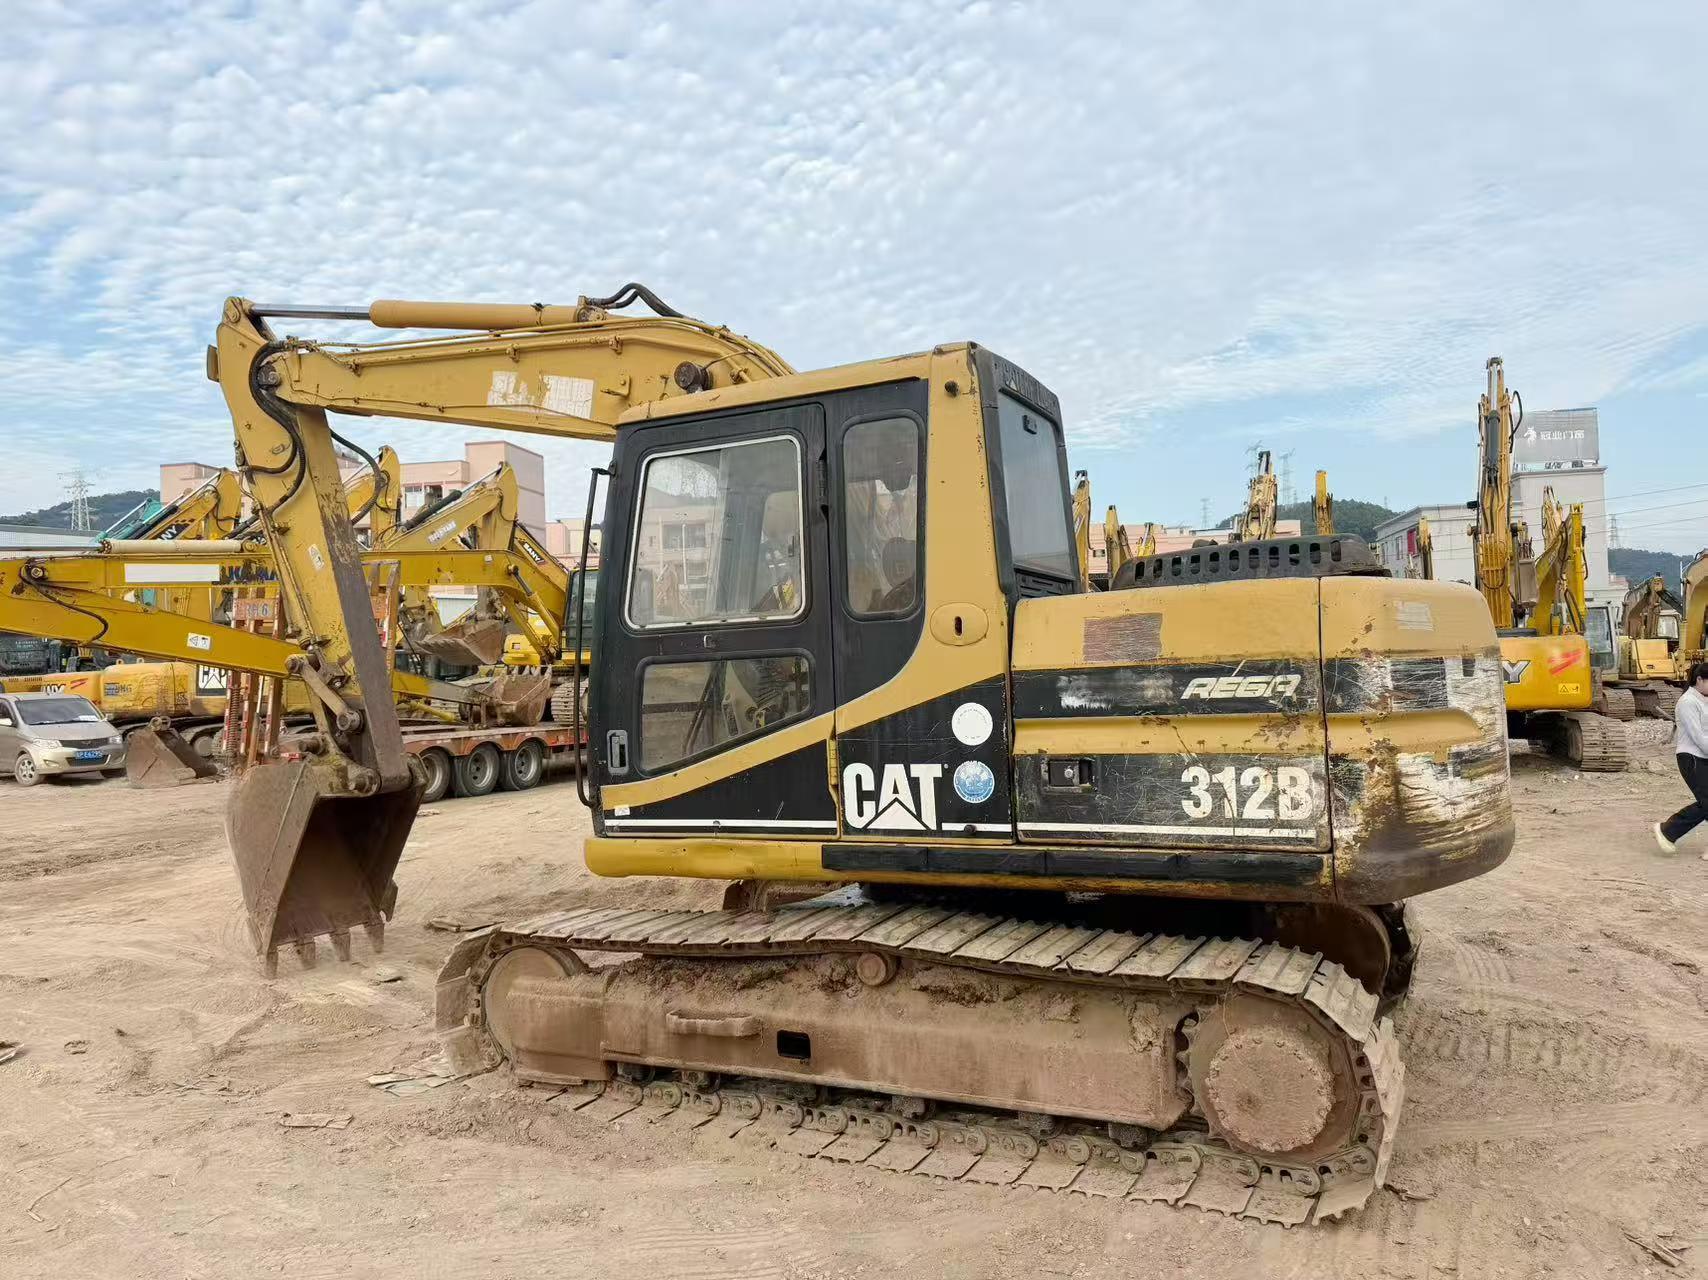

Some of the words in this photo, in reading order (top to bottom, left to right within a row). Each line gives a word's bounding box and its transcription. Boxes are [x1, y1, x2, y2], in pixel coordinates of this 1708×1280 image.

[523, 542, 541, 562] SANY
[843, 762, 943, 831] CAT
[1181, 766, 1313, 820] 312B
